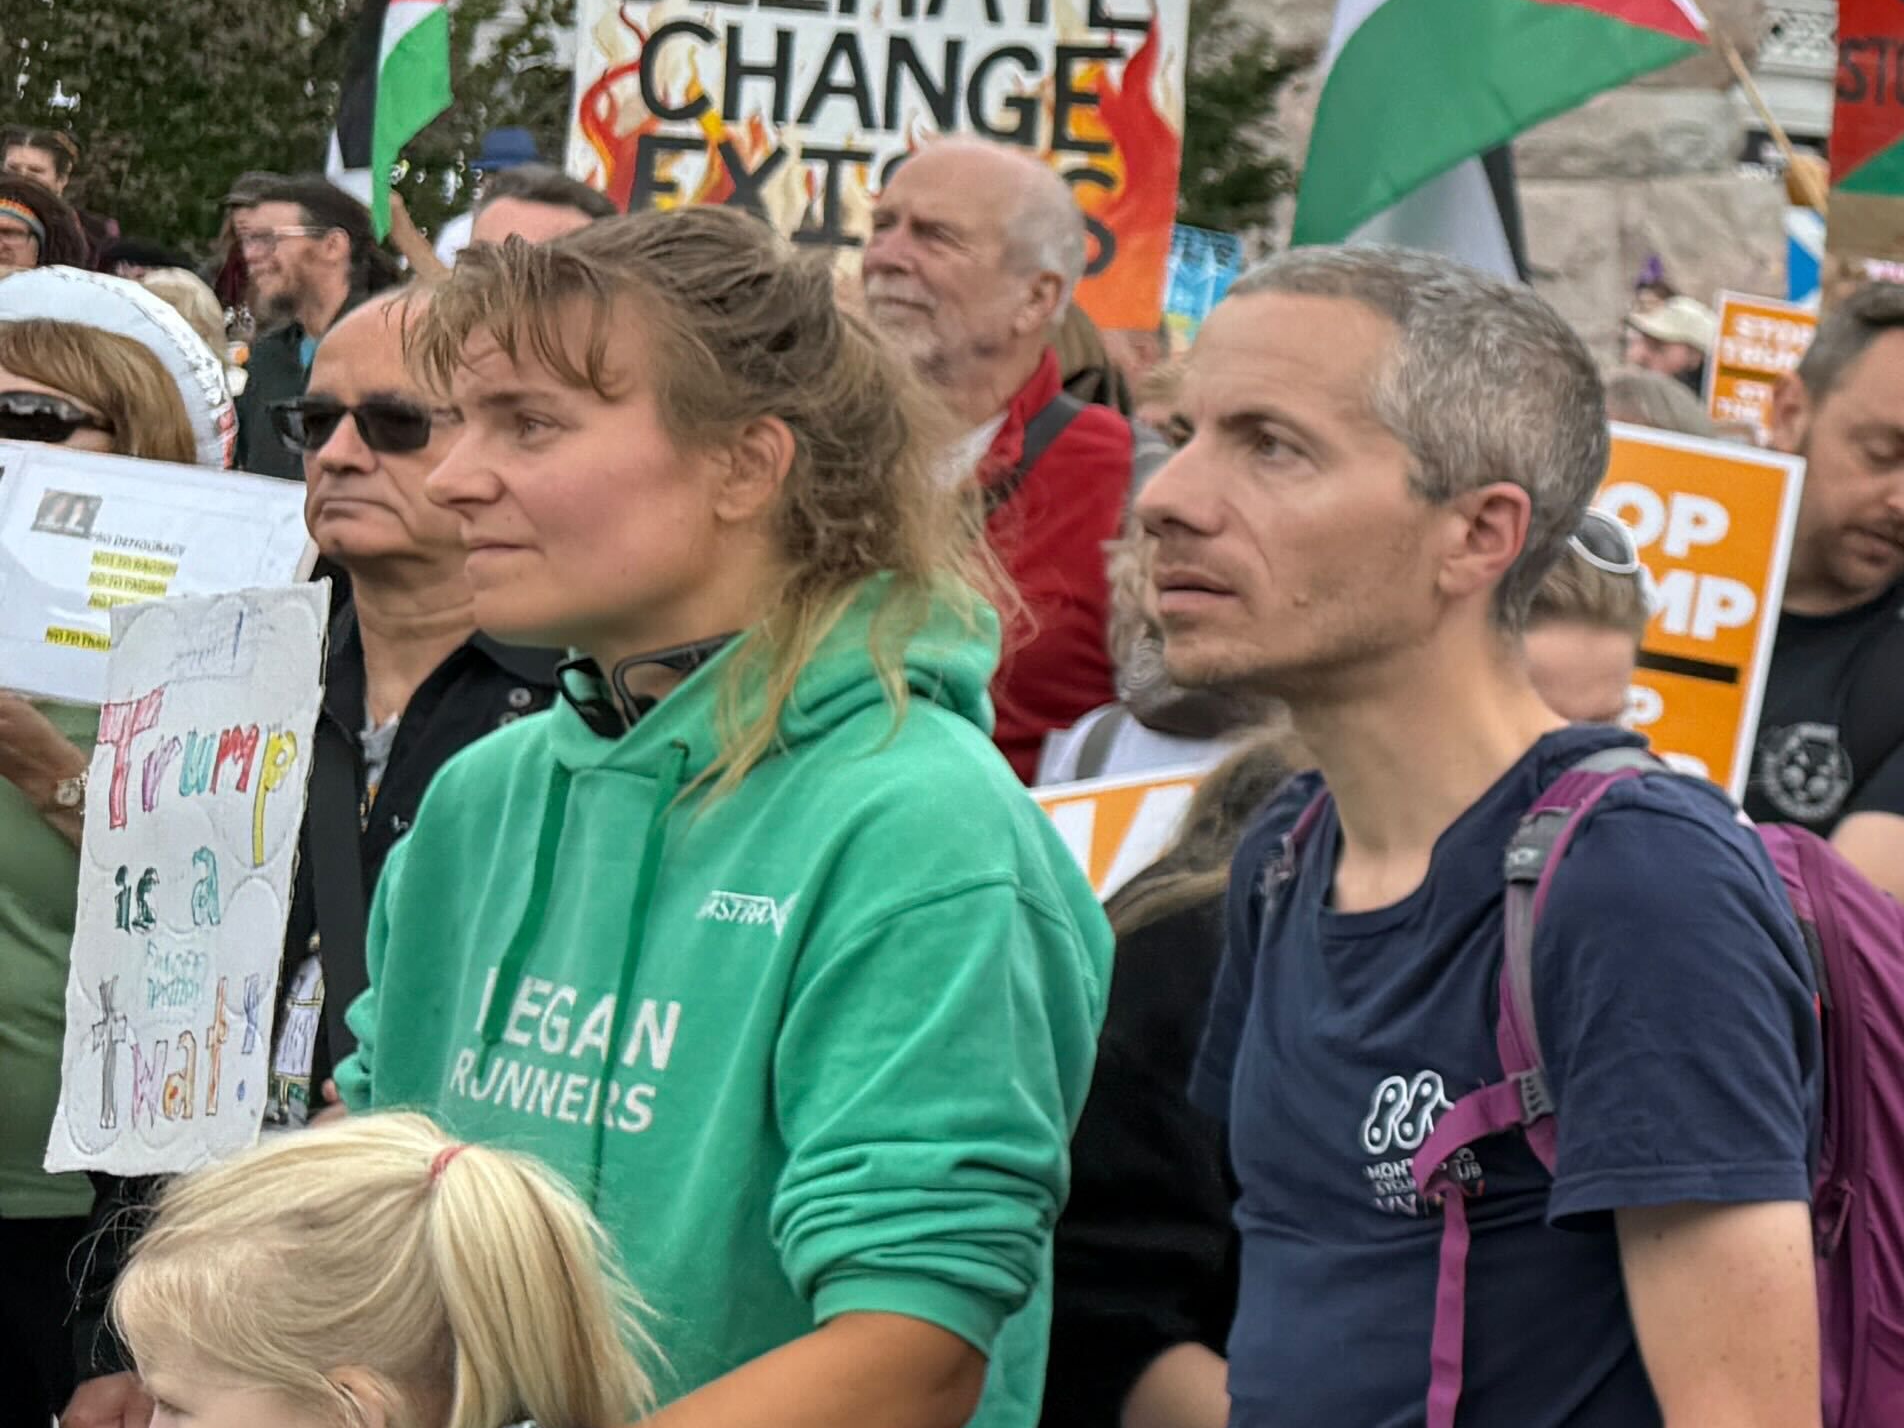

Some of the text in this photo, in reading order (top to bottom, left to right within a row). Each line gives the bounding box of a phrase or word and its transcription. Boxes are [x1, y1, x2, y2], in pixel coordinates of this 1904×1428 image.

[638, 20, 1127, 154] CHANGE
[1598, 482, 1730, 559] OP
[97, 685, 297, 866] Trump
[114, 846, 221, 935] is a
[450, 1047, 656, 1133] RUNNERS
